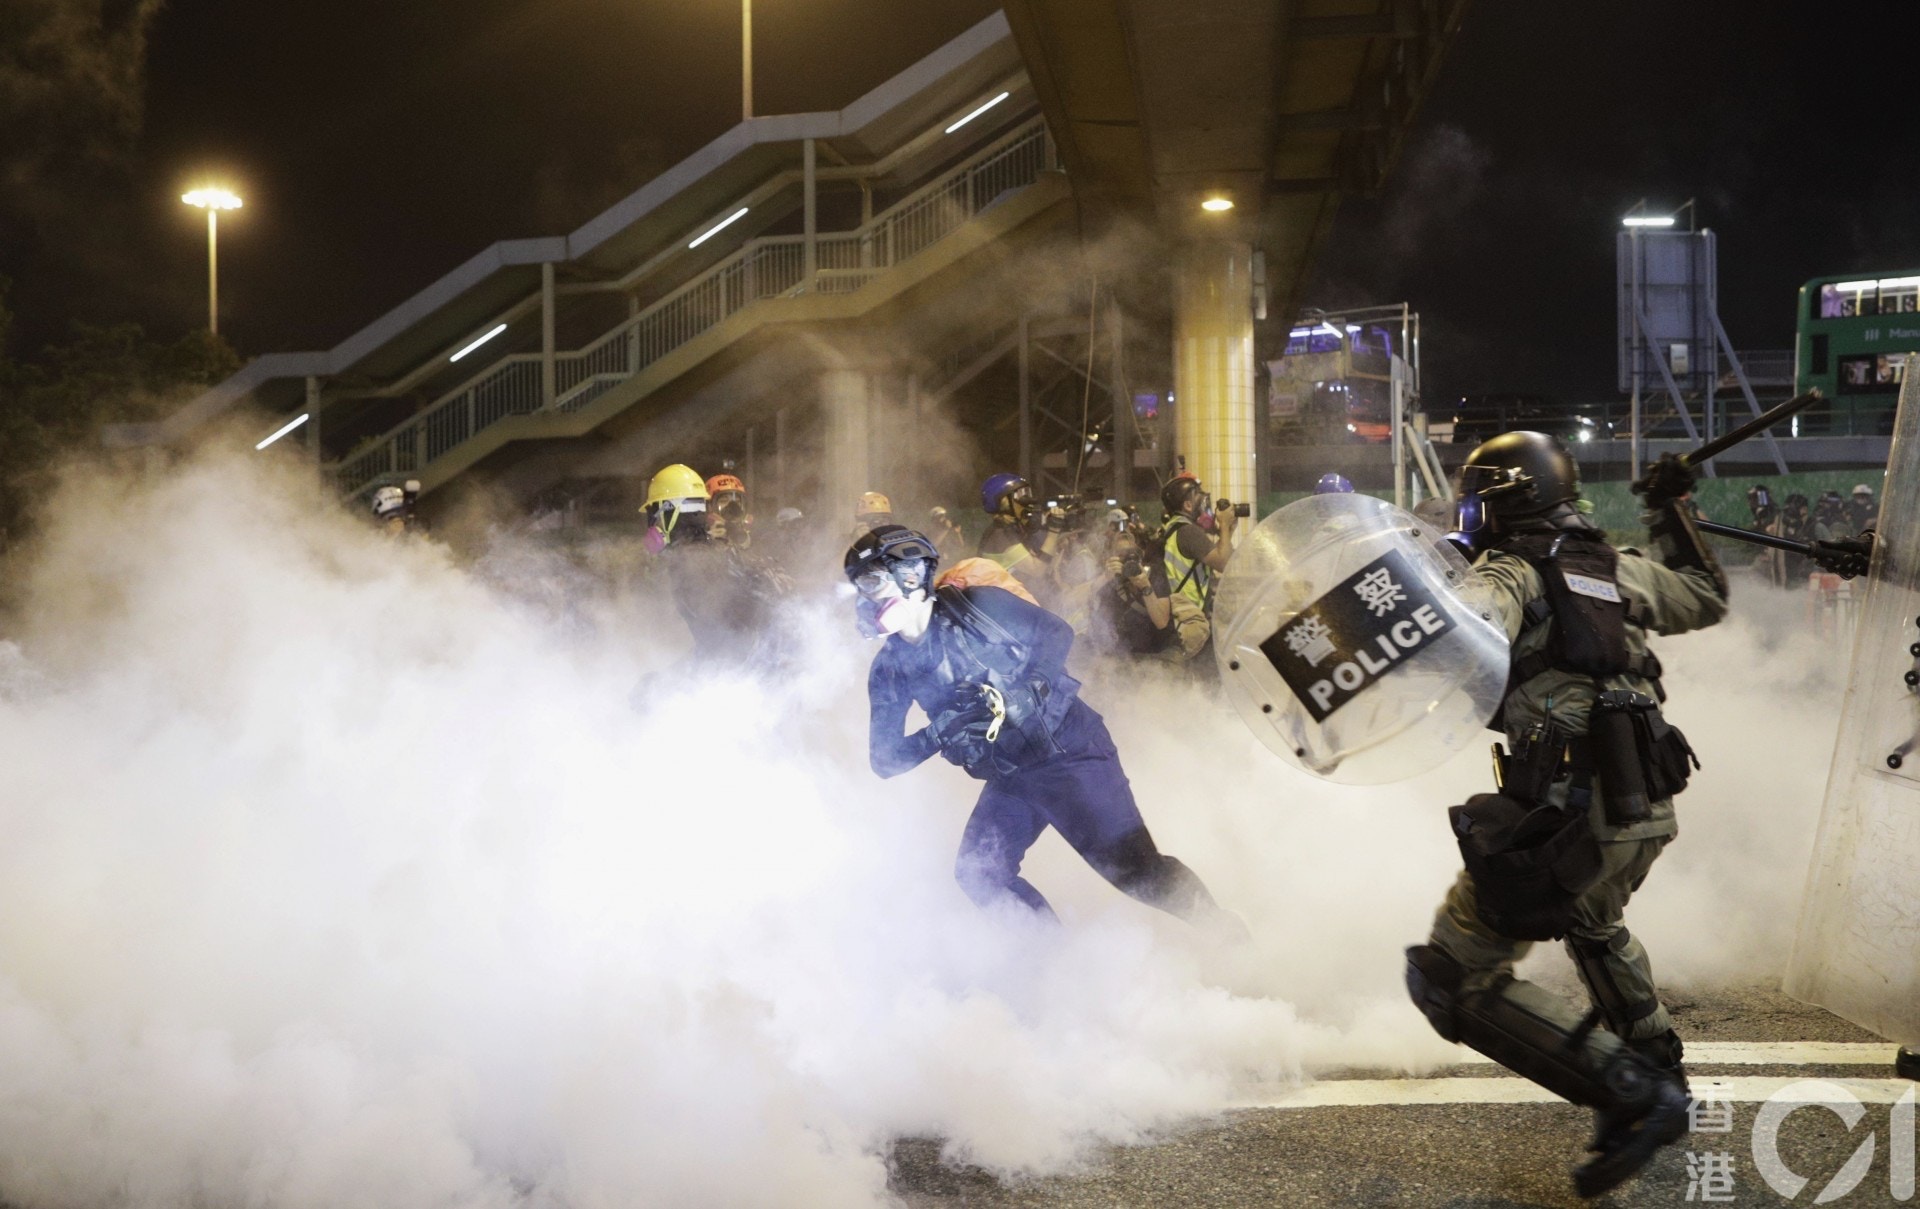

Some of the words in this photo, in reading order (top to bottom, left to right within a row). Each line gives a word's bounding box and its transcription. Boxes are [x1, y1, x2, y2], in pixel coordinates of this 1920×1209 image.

[1284, 567, 1407, 667] 警察
[1569, 578, 1616, 598] POLICE
[1308, 603, 1446, 712] POLICE
